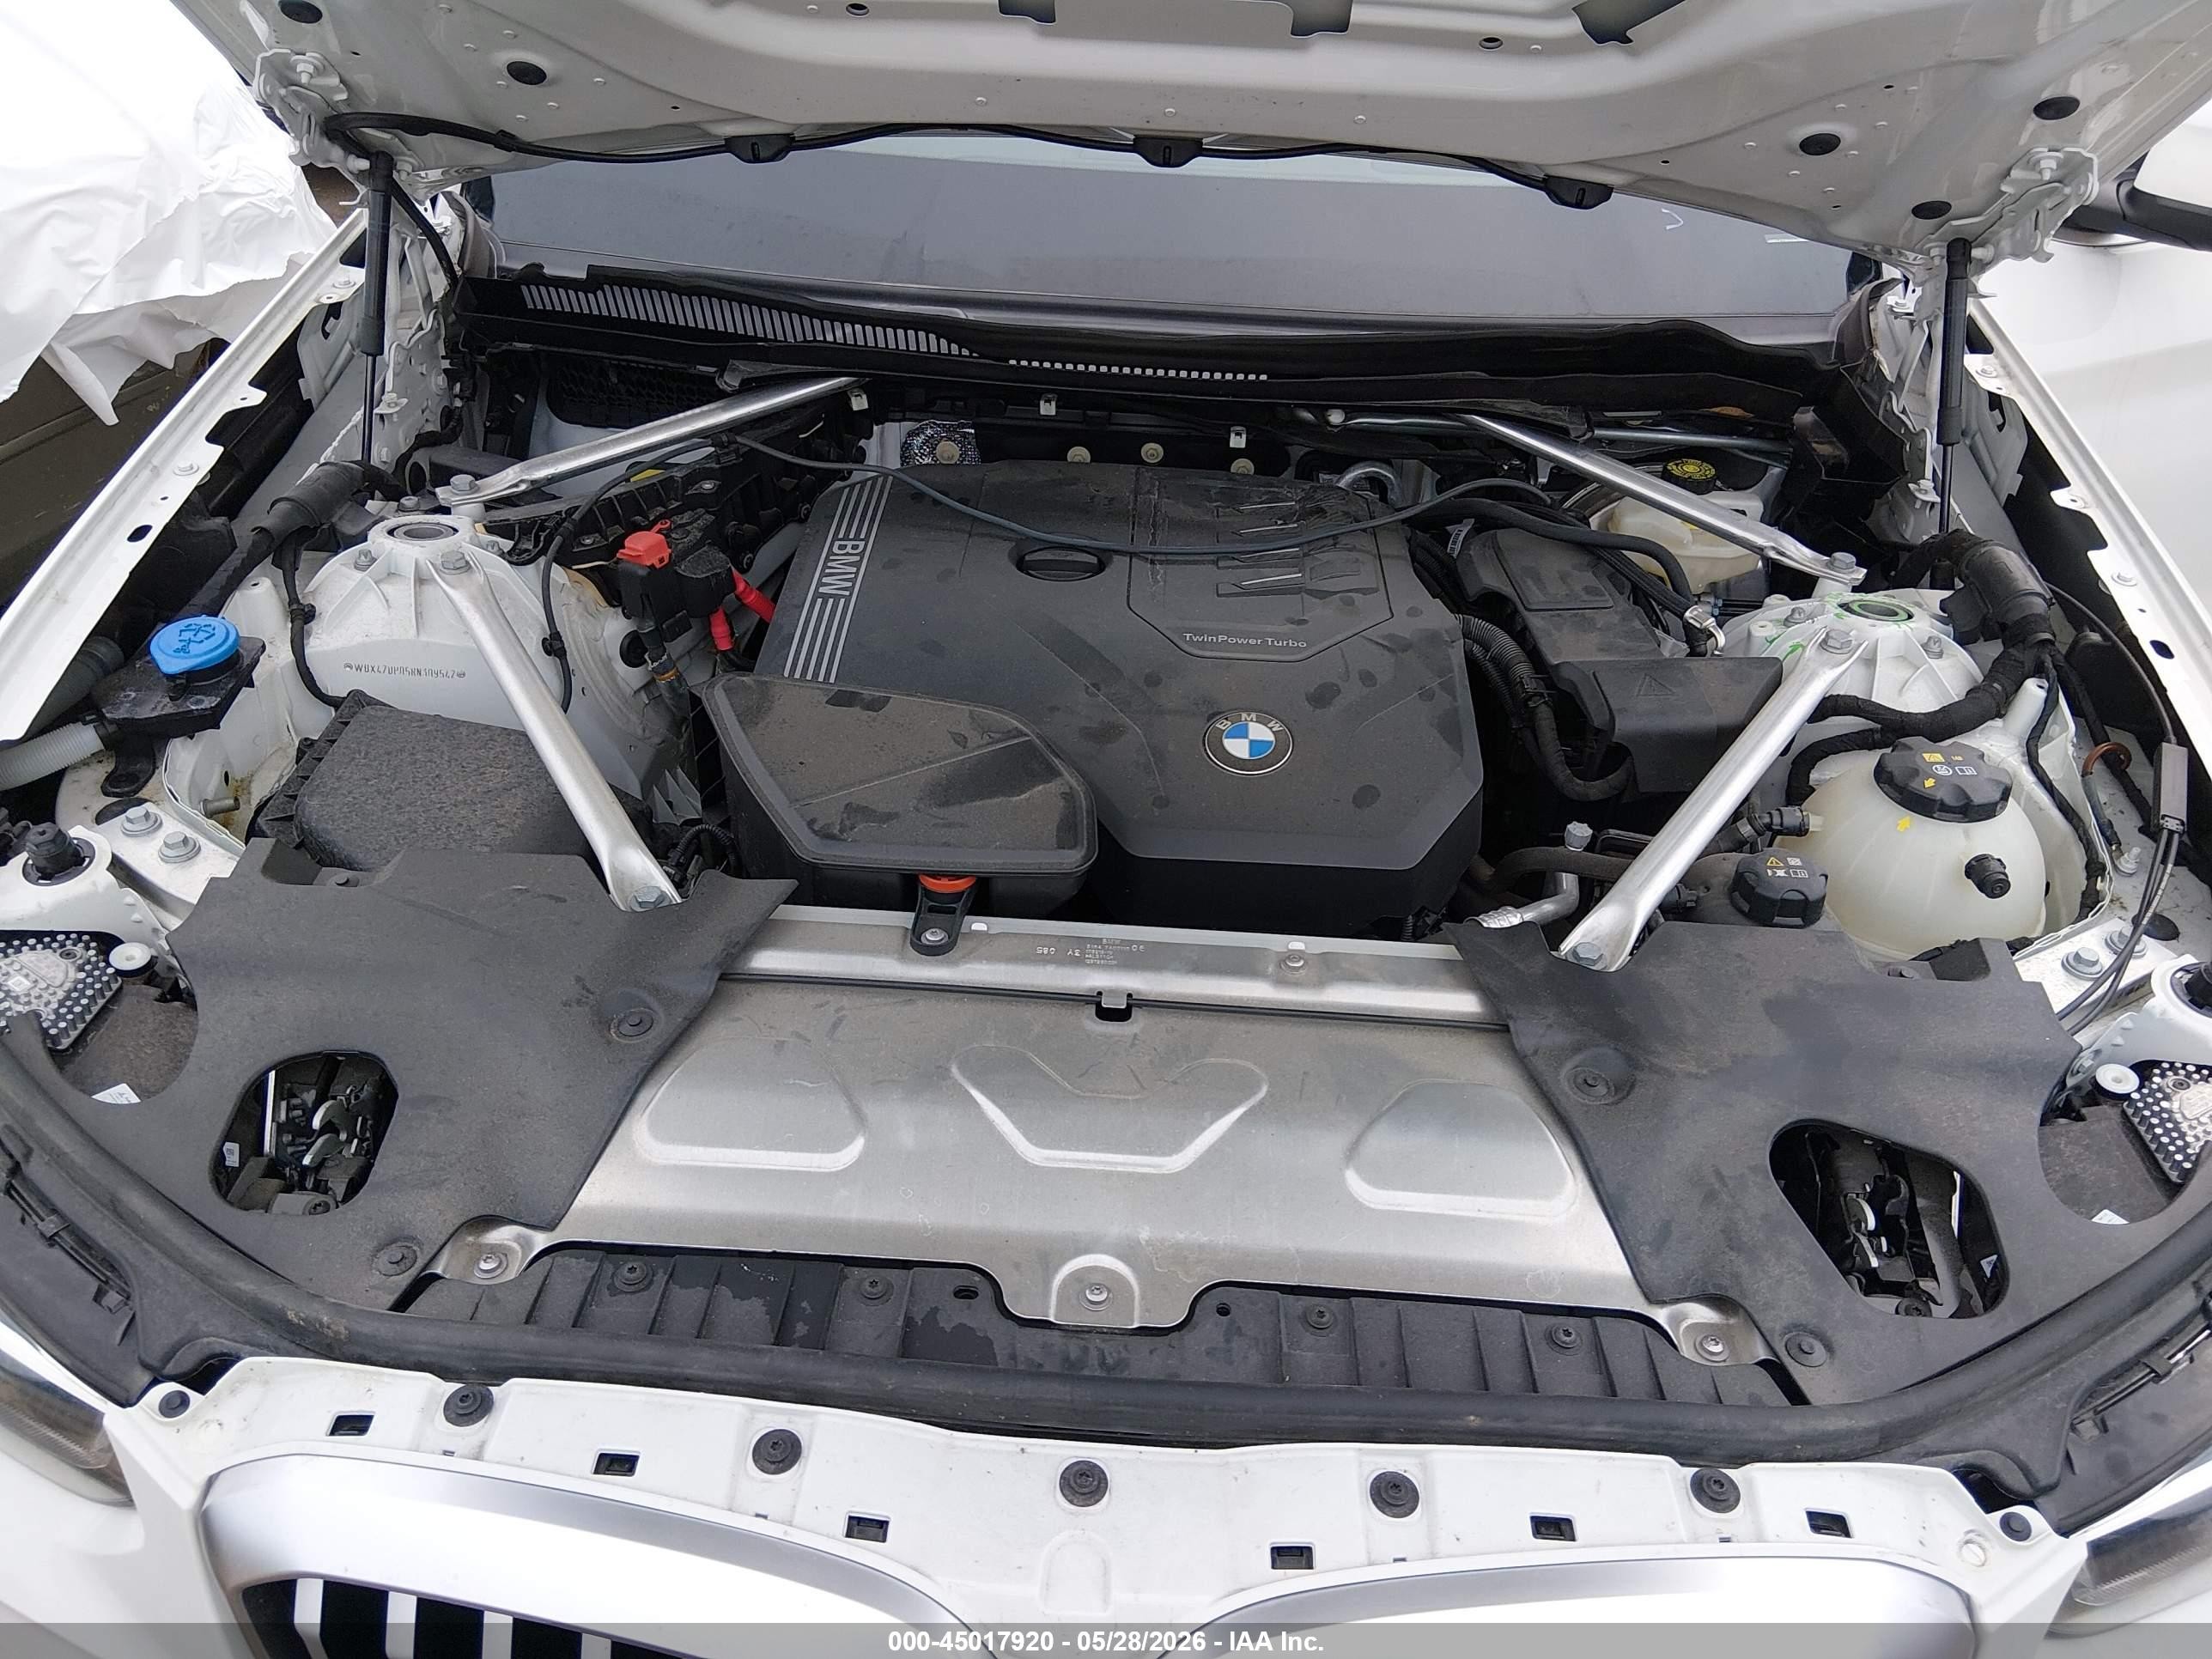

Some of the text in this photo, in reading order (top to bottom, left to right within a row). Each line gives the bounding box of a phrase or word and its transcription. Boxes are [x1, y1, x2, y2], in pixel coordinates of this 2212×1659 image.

[818, 540, 866, 596] BMW
[1264, 637, 1307, 647] Turbo
[1215, 713, 1285, 732] BMW
